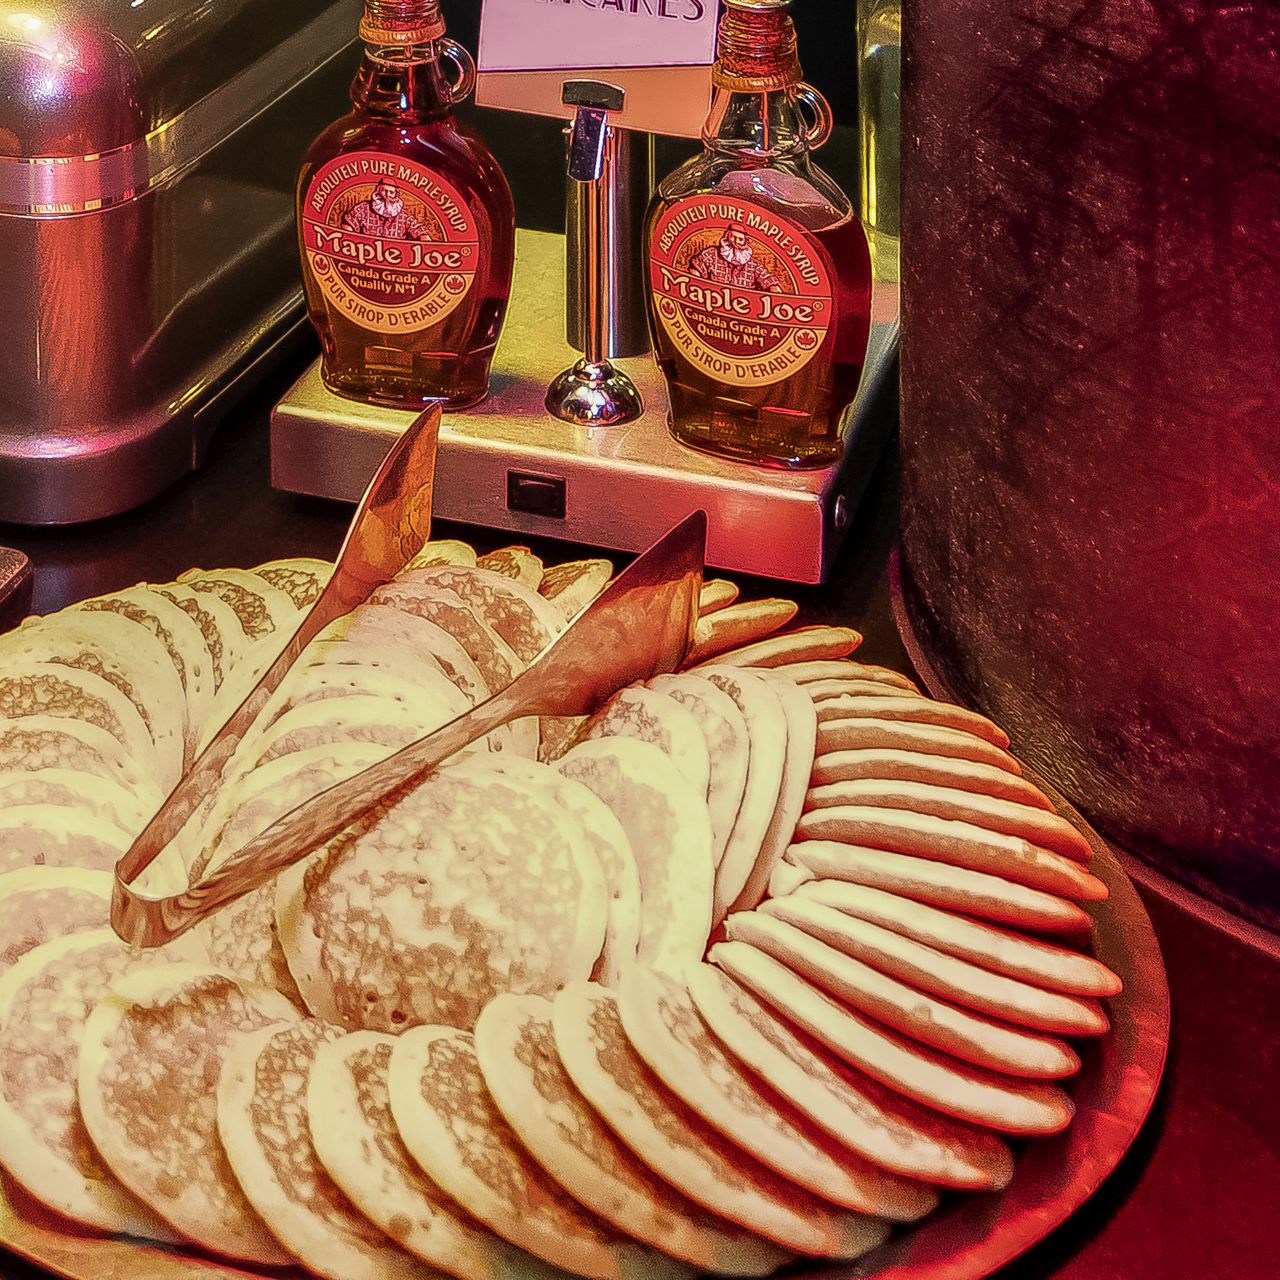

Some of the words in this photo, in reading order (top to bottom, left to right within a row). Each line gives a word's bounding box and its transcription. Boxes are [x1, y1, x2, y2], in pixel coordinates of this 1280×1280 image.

[311, 161, 359, 213] ABSOLUTELY
[361, 160, 395, 176] PURE
[397, 165, 442, 198] MAPLE
[436, 194, 468, 232] SYRUP
[313, 225, 402, 265] Maple
[658, 204, 707, 254] ABSOLUTELY
[709, 204, 745, 222] PURE
[746, 212, 793, 248] MAPLE
[786, 244, 821, 285] SYRUP
[337, 262, 379, 279] Canada
[382, 270, 419, 284] Grade
[420, 274, 431, 285] A
[351, 276, 391, 294] Quality
[661, 267, 750, 312] Maple
[324, 274, 344, 303] PUR
[346, 298, 384, 324] SIROP
[387, 292, 451, 326] D'ERABLE
[684, 307, 727, 329] Canada
[729, 321, 768, 337] Grade
[770, 327, 780, 338] A
[697, 322, 740, 345] Quality
[670, 320, 693, 349] PUR
[691, 345, 732, 375] SIROP
[734, 346, 801, 378] D'ERABLE
